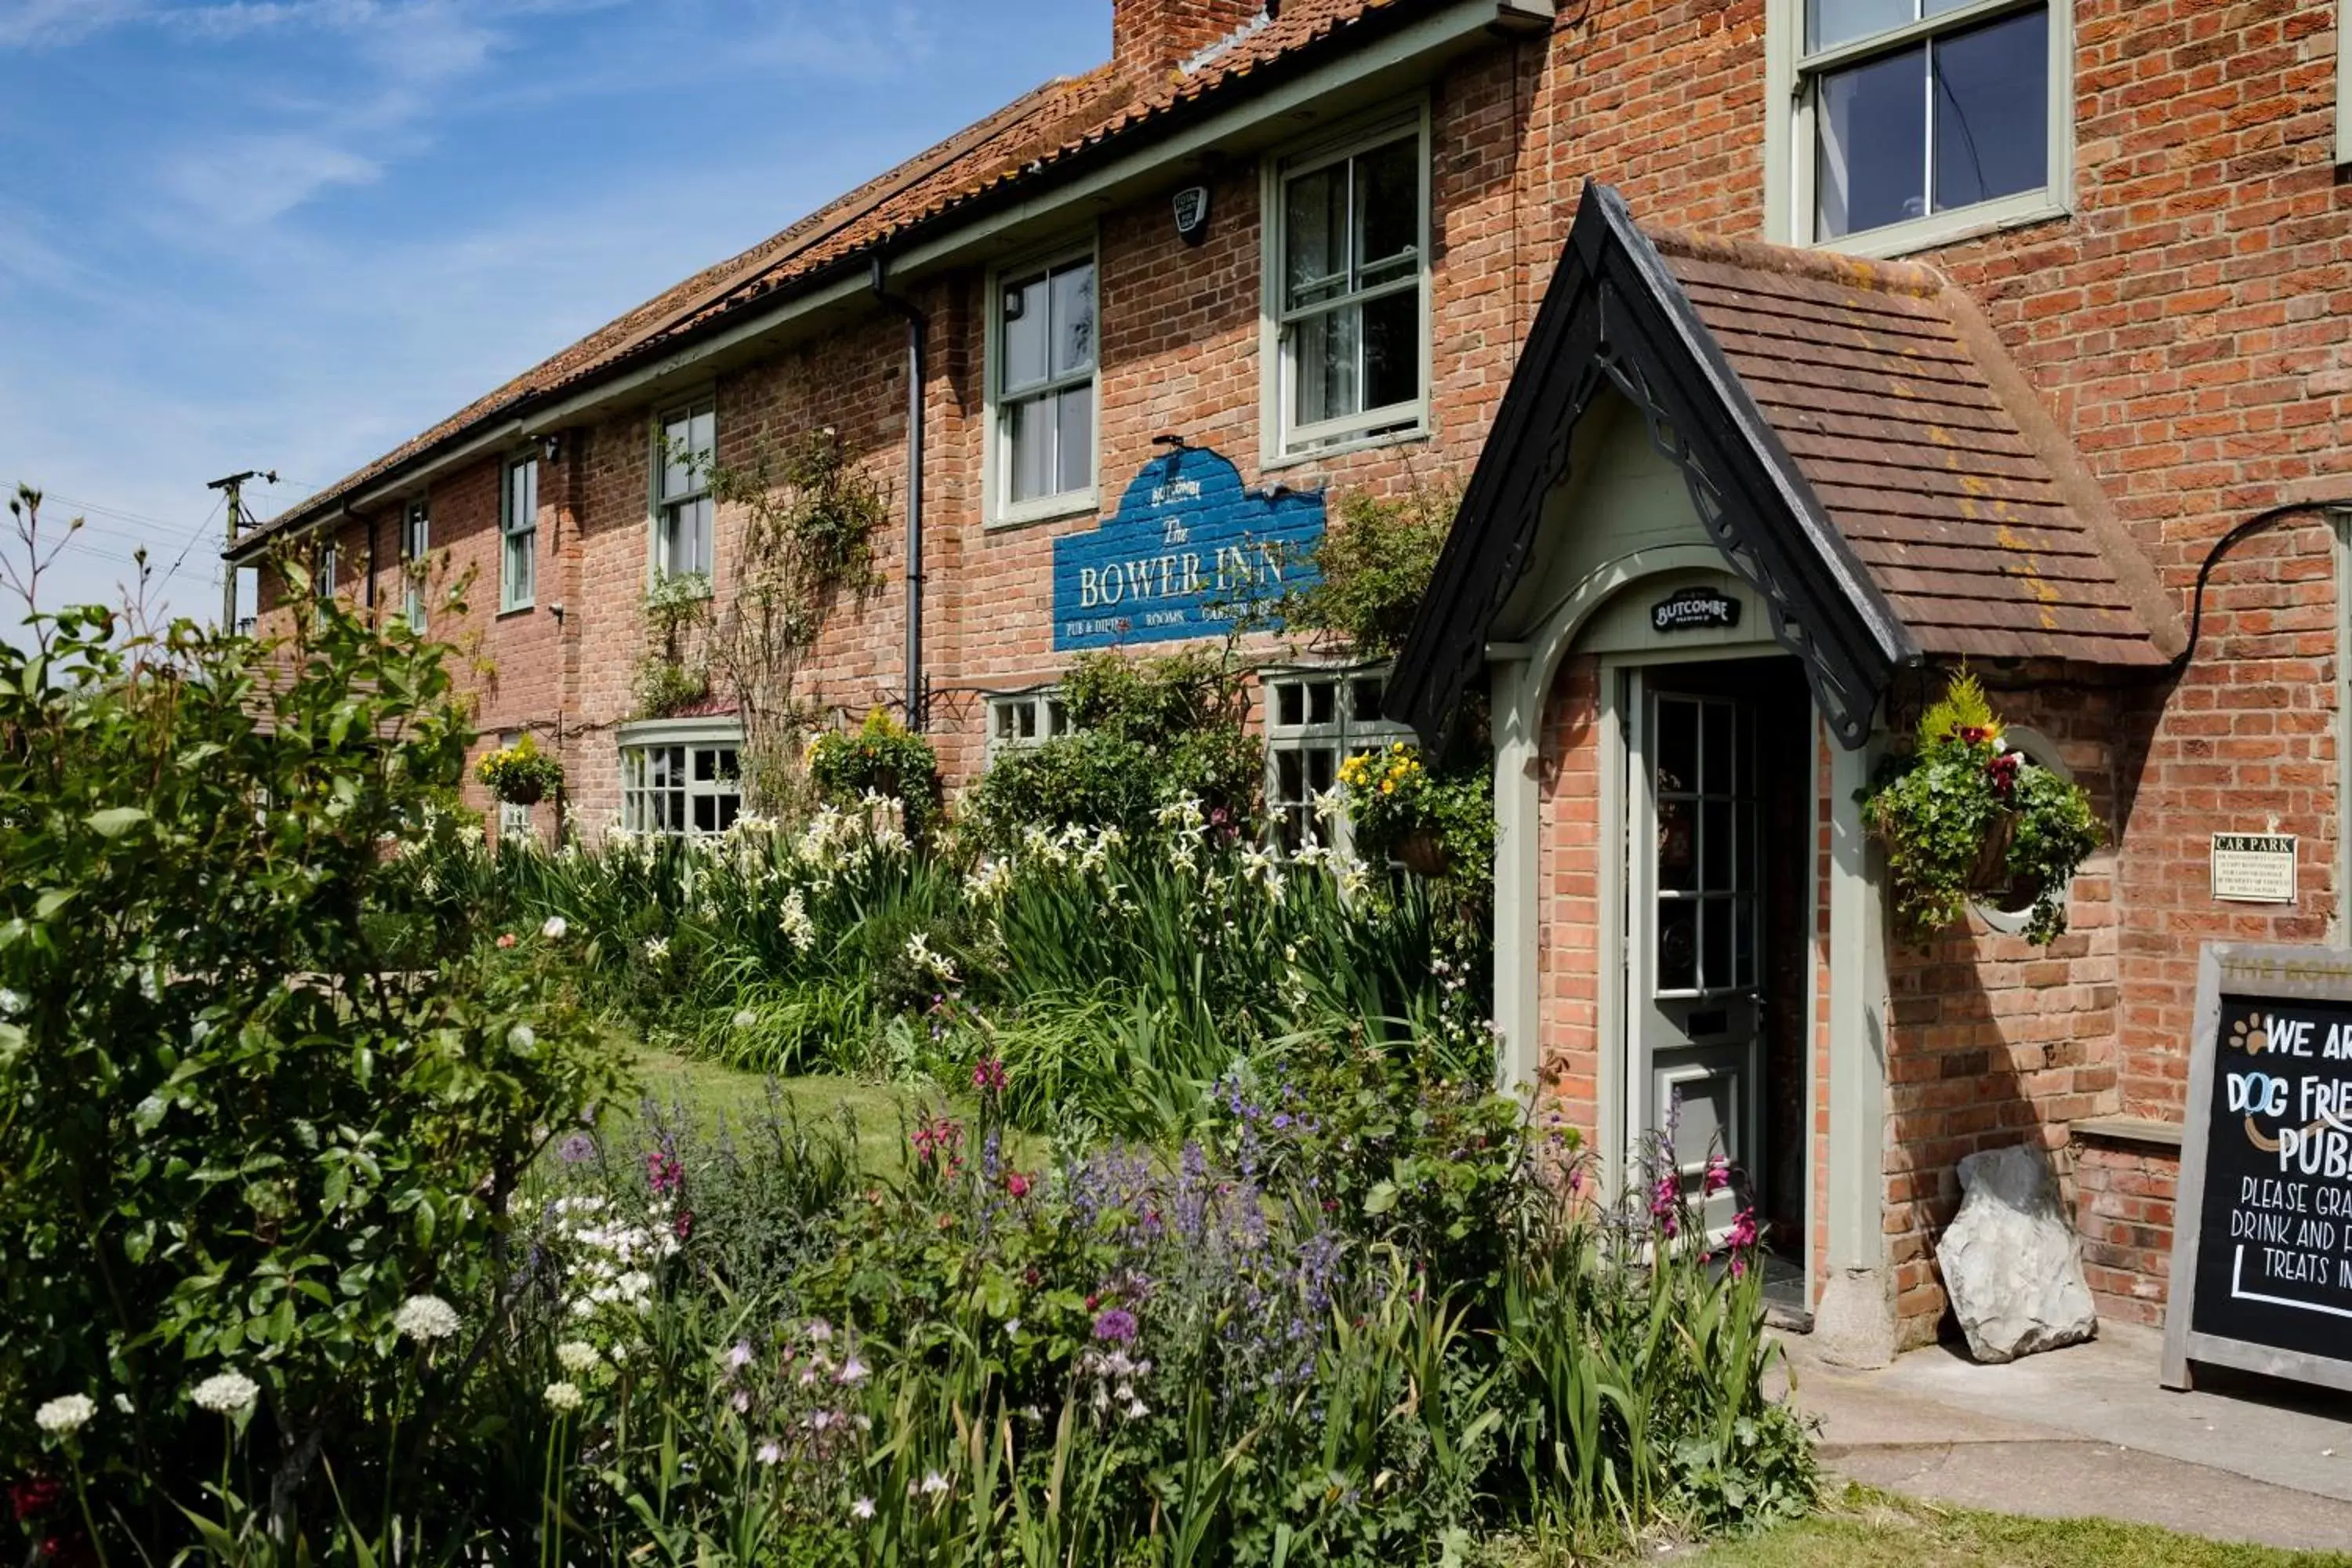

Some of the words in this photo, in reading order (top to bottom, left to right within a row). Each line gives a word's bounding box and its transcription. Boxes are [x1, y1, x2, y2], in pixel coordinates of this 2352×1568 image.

[1163, 515, 1189, 545] The
[1079, 552, 1201, 608] BOWER
[1214, 539, 1285, 590] INN
[1145, 610, 1185, 626] ROOMS
[1656, 600, 1728, 626] BUTCOMBE
[2216, 838, 2245, 851] CAR
[2249, 838, 2289, 852] PARK
[2226, 956, 2275, 979] THE
[2265, 1014, 2315, 1057] WE
[2227, 1072, 2288, 1116] DOG
[2241, 1176, 2309, 1213] PLEASE
[2230, 1209, 2292, 1244] DRINK
[2296, 1219, 2335, 1250] AND
[2263, 1247, 2329, 1284] TREATS
